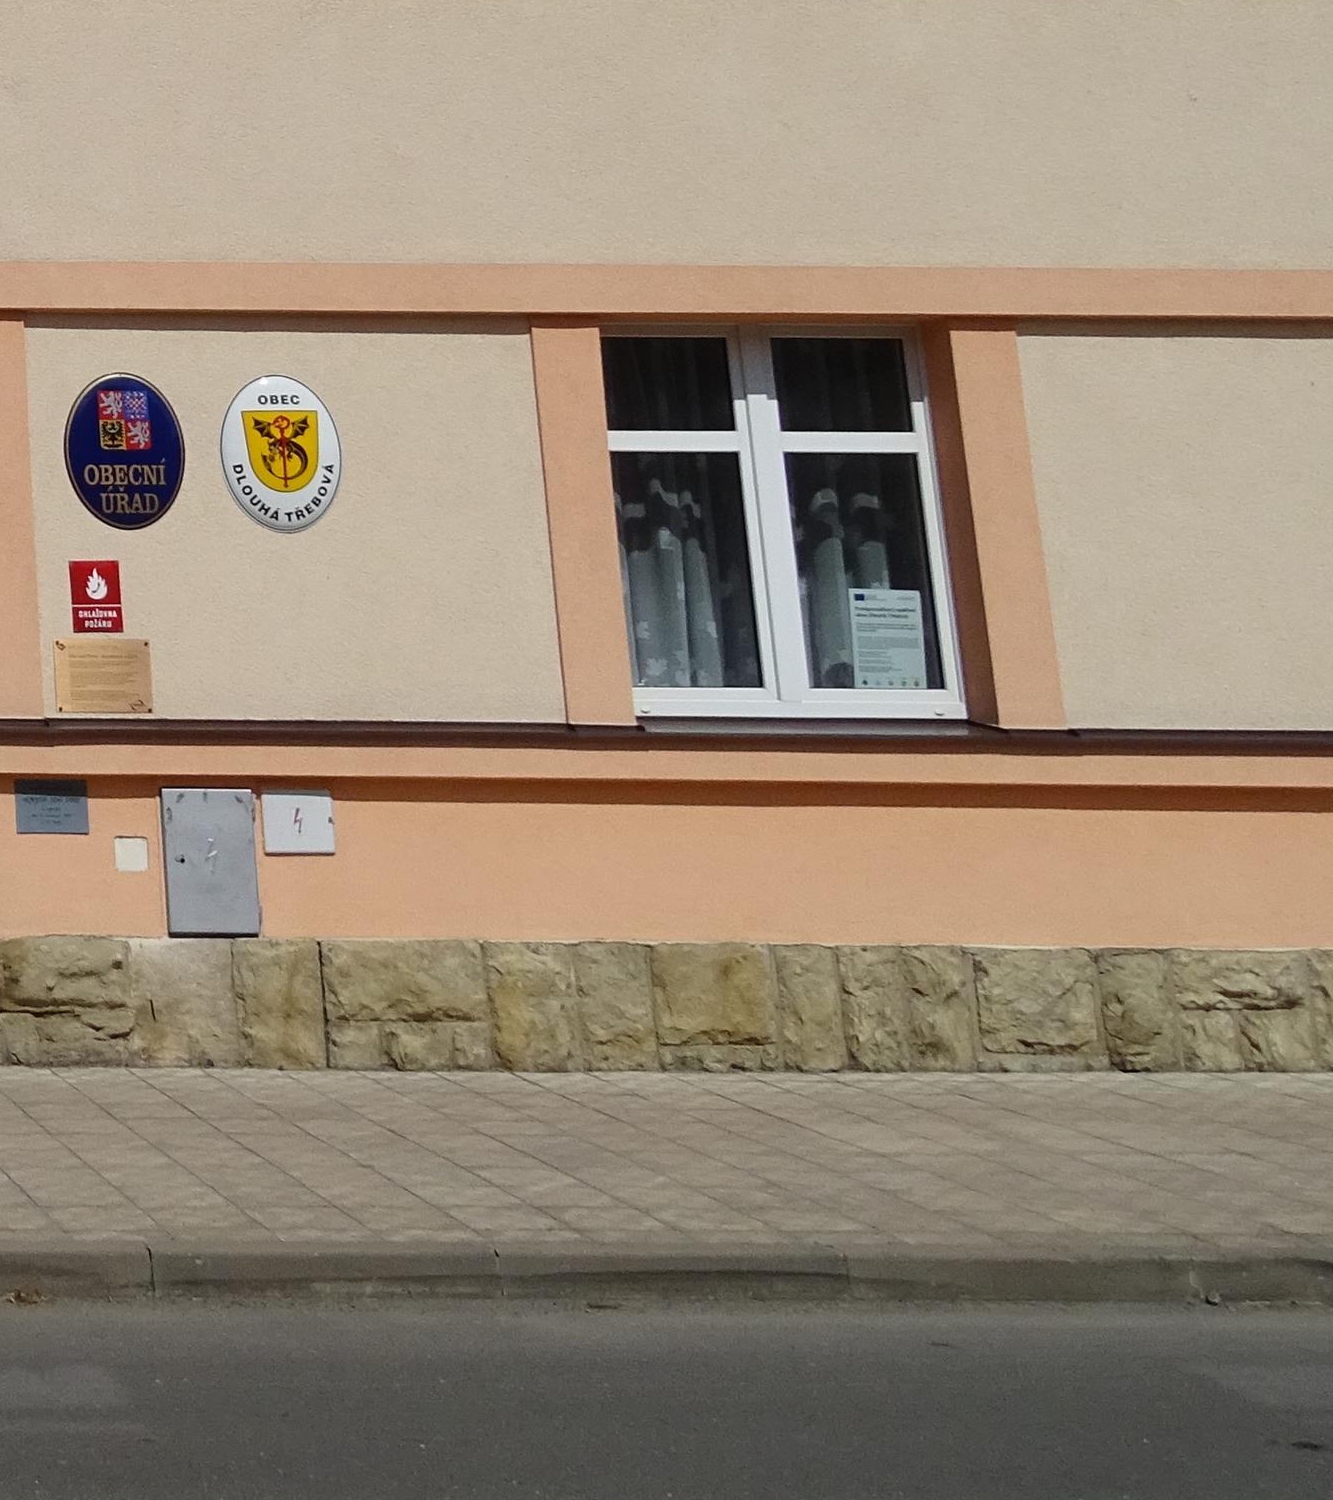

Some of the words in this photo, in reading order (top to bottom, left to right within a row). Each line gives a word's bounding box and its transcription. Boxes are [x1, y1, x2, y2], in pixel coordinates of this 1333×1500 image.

[257, 394, 301, 406] OBEC
[83, 457, 167, 486] OBECNÍ
[99, 486, 160, 514] ÚŘAD
[232, 463, 281, 521] DLOUHÁ
[284, 463, 335, 523] TŘEBOVÁ
